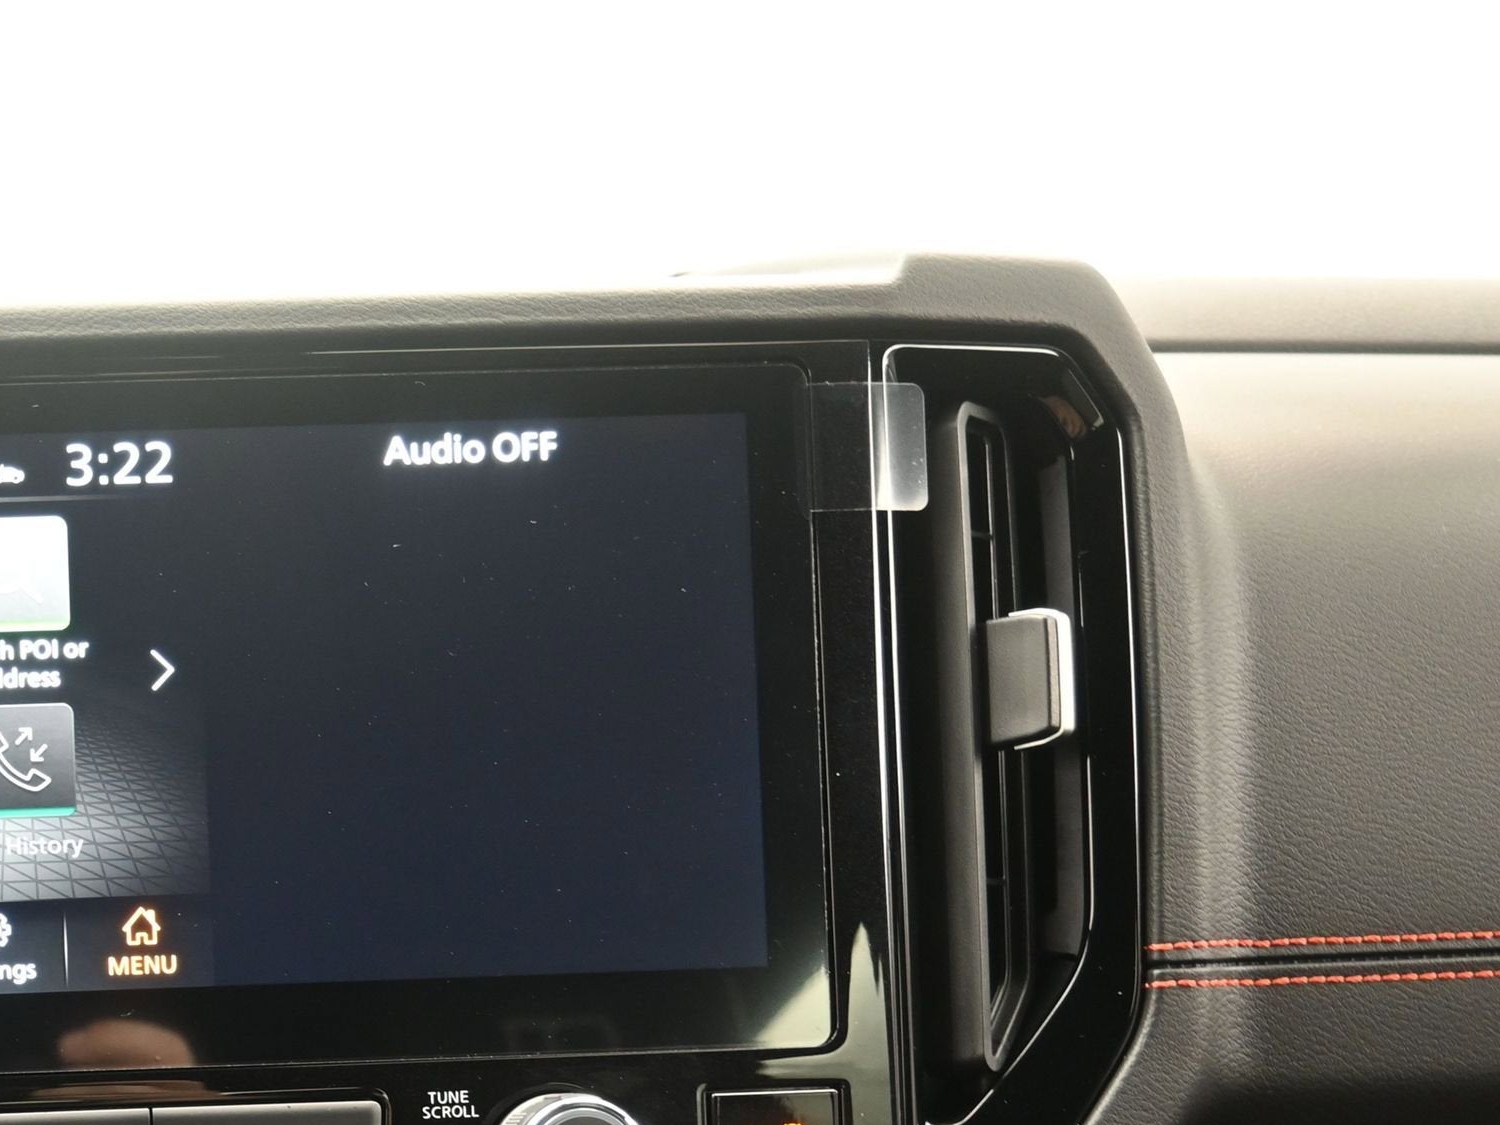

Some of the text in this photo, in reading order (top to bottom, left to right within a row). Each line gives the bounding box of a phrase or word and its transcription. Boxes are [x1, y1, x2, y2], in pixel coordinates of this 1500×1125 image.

[383, 431, 558, 466] Audio OFF
[64, 440, 174, 487] 3:22
[19, 638, 60, 662] POI
[63, 641, 89, 662] or
[6, 836, 85, 859] History
[107, 953, 178, 978] MENU
[427, 1090, 470, 1105] TUNE
[422, 1105, 479, 1120] SCROLL
